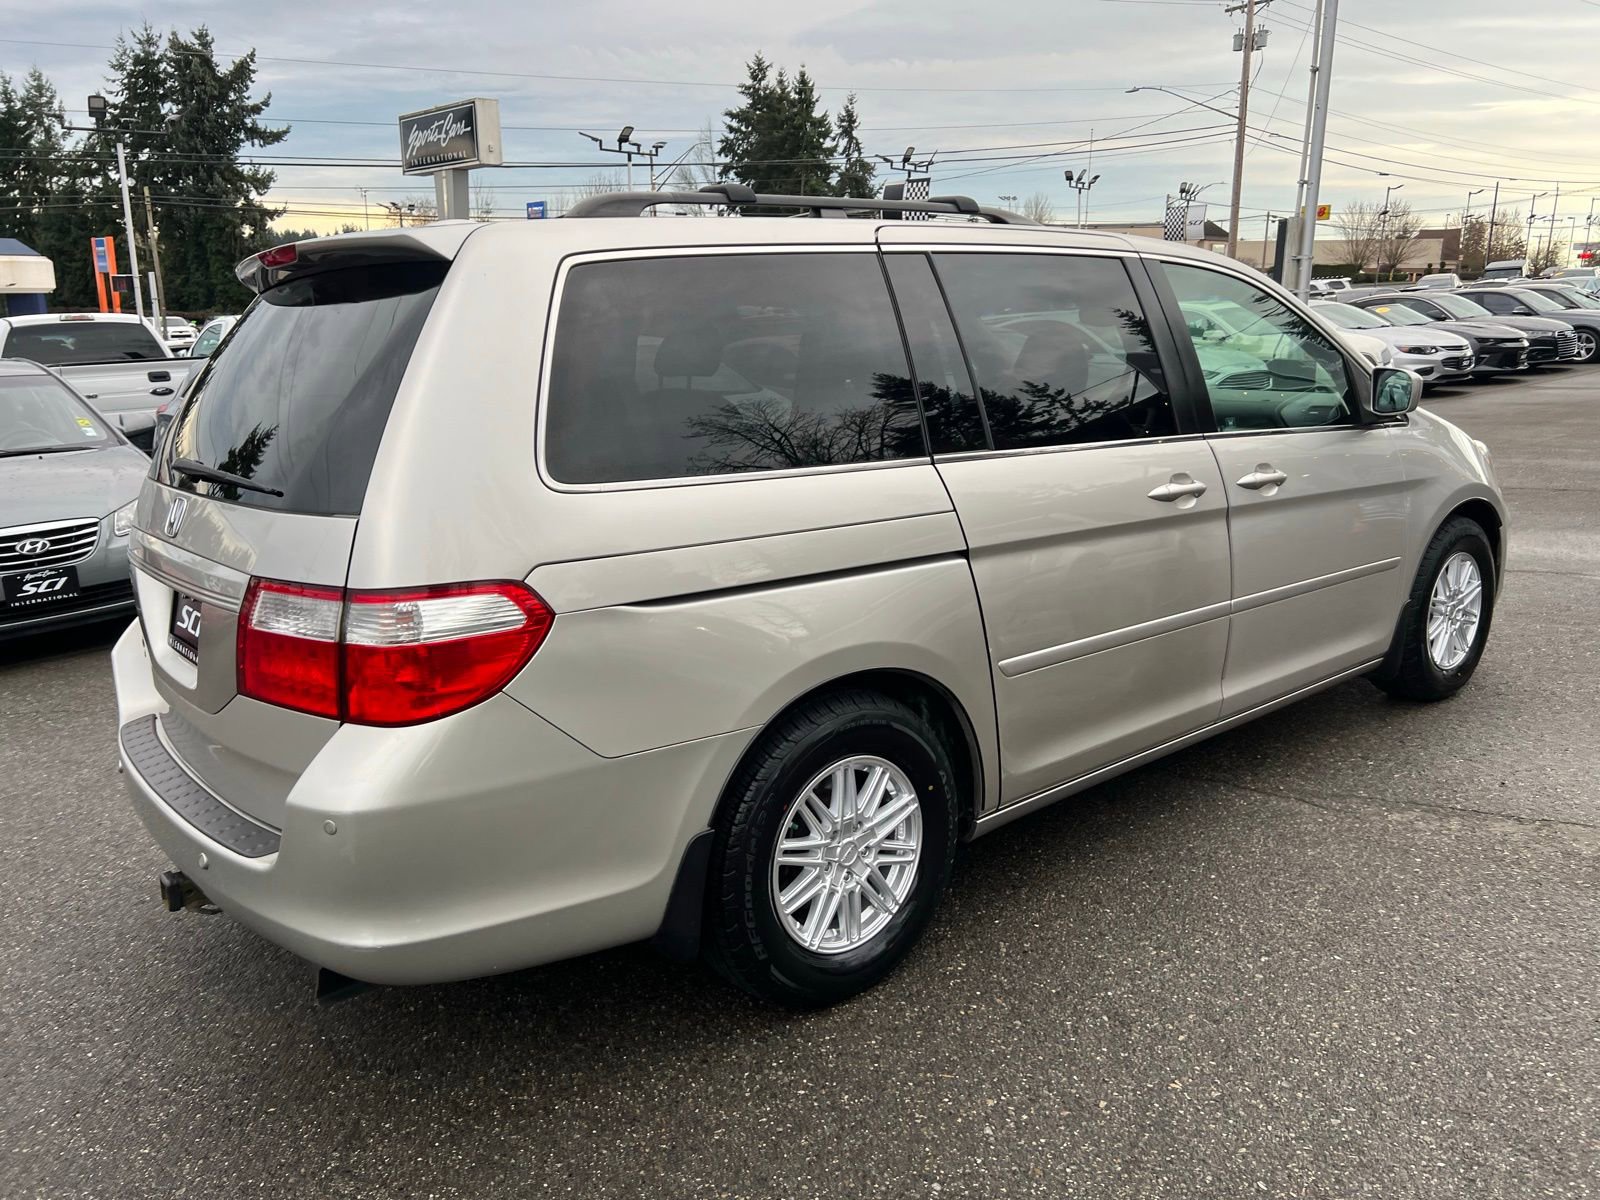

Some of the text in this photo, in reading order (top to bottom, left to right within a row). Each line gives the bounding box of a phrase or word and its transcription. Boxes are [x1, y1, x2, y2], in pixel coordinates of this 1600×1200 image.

[406, 113, 472, 160] Sports Cars
[411, 150, 467, 166] INTERNATIONAL
[16, 576, 69, 597] SCI
